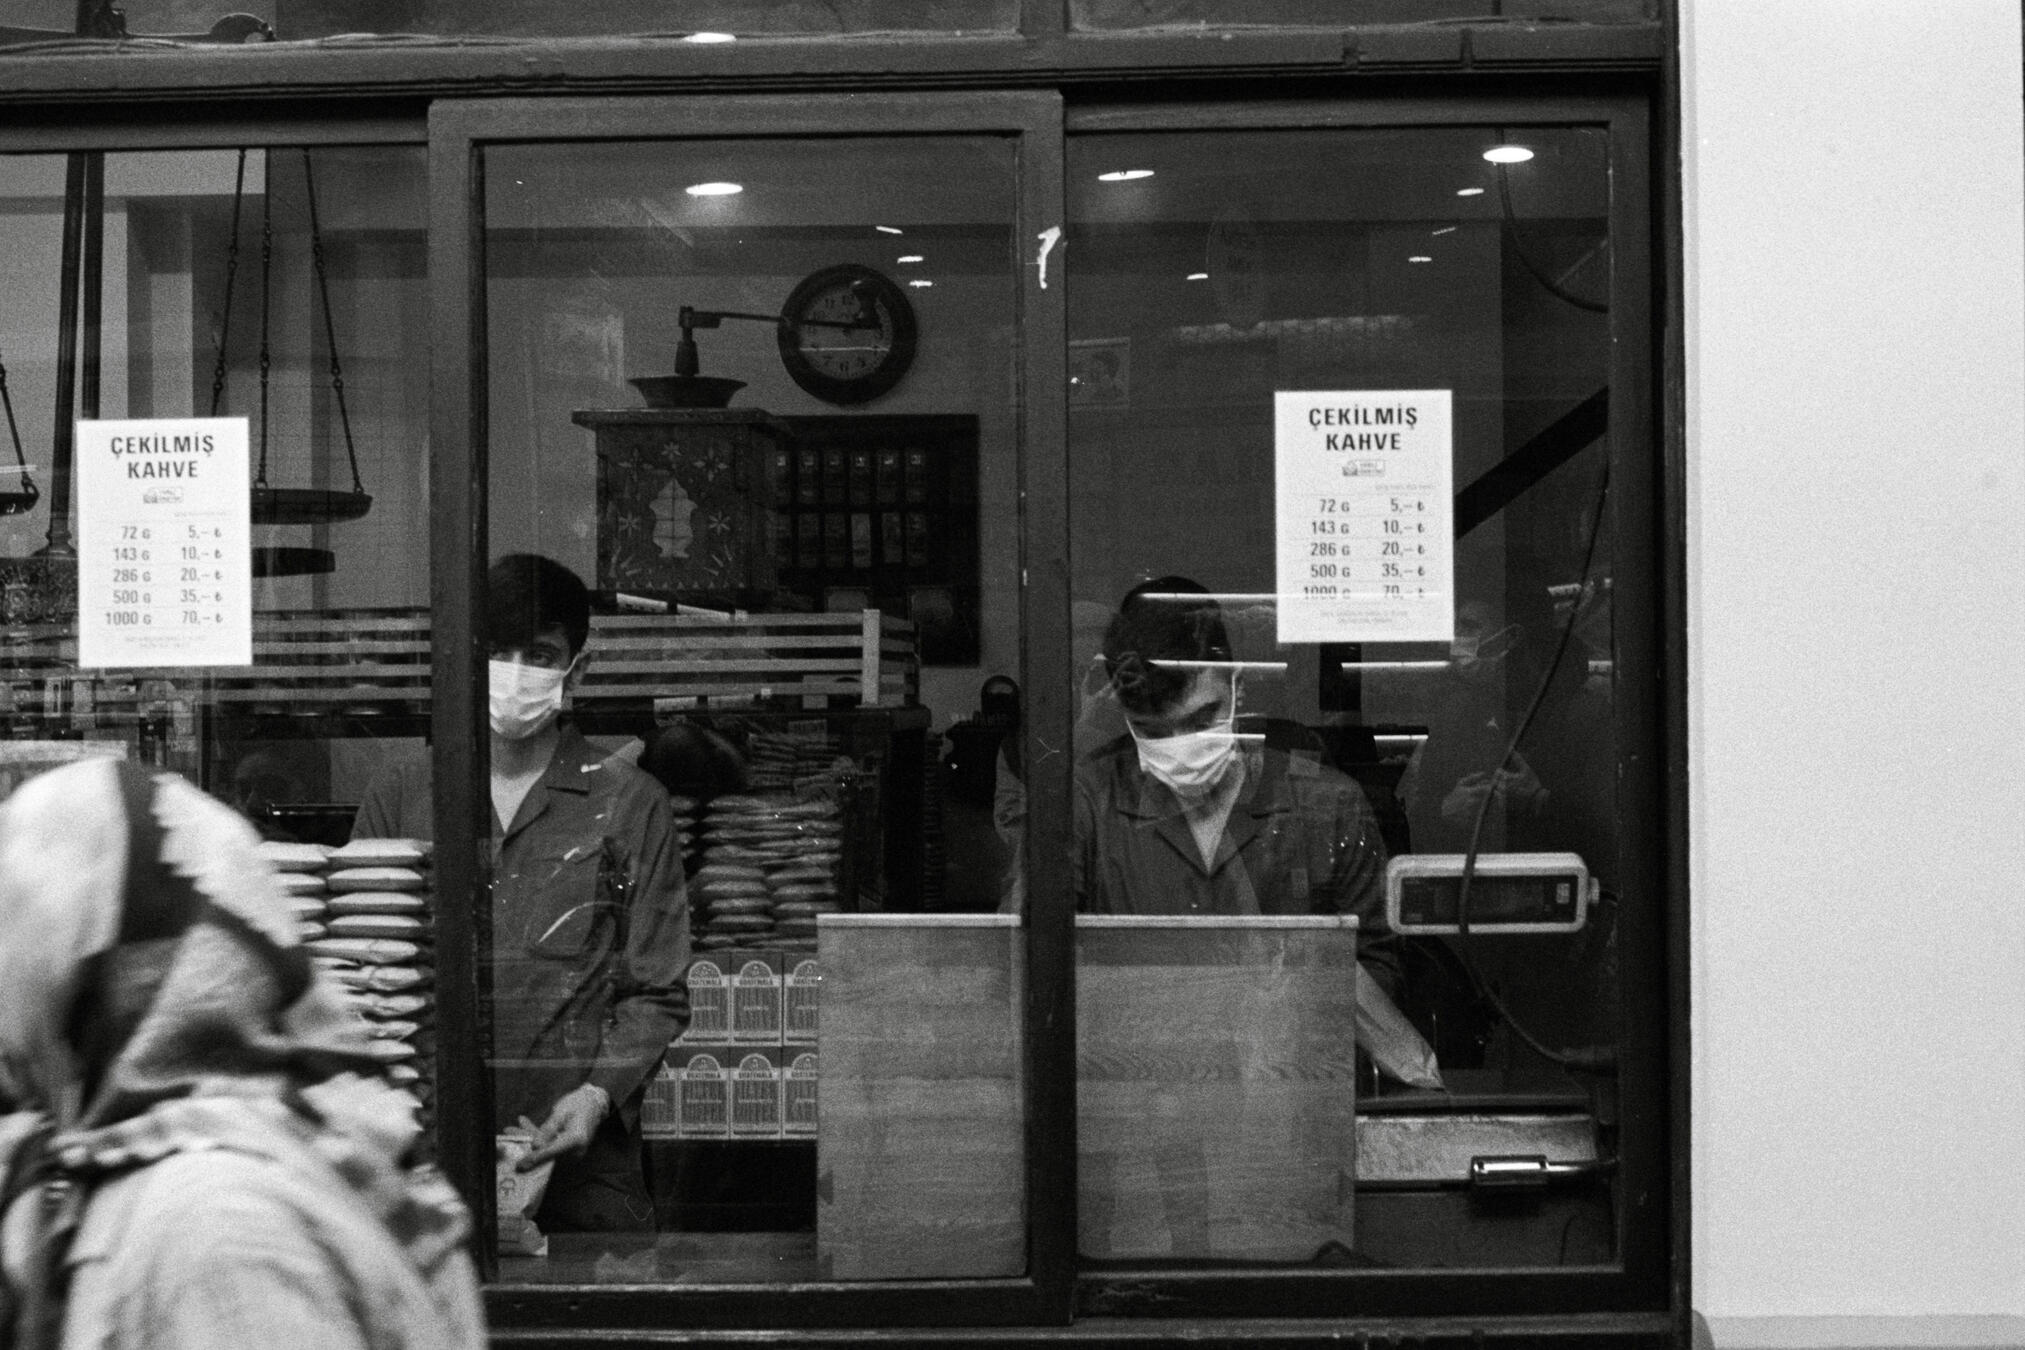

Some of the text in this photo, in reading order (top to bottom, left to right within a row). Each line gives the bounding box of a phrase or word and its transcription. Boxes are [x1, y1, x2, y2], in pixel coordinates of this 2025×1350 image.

[1309, 403, 1418, 431] ÇEKİLMİŞ
[110, 433, 215, 460] ÇEKİLMİŞ
[1326, 433, 1402, 451] KAHVE
[127, 461, 198, 479] KAHVE
[1319, 499, 1336, 513] 72
[1340, 501, 1350, 513] G
[121, 526, 139, 540] 72
[142, 529, 152, 540] G
[1311, 520, 1336, 535] 143
[1340, 523, 1350, 535] G
[113, 547, 138, 561] 143
[141, 550, 151, 561] G
[1310, 542, 1337, 557] 286
[1341, 545, 1351, 557] G
[112, 568, 139, 583] 286
[142, 571, 152, 583] G
[1310, 563, 1338, 578] 500
[1341, 566, 1351, 578] G
[112, 590, 139, 604] 500
[142, 593, 152, 604] G
[105, 611, 139, 626] 1000
[142, 614, 152, 626] G
